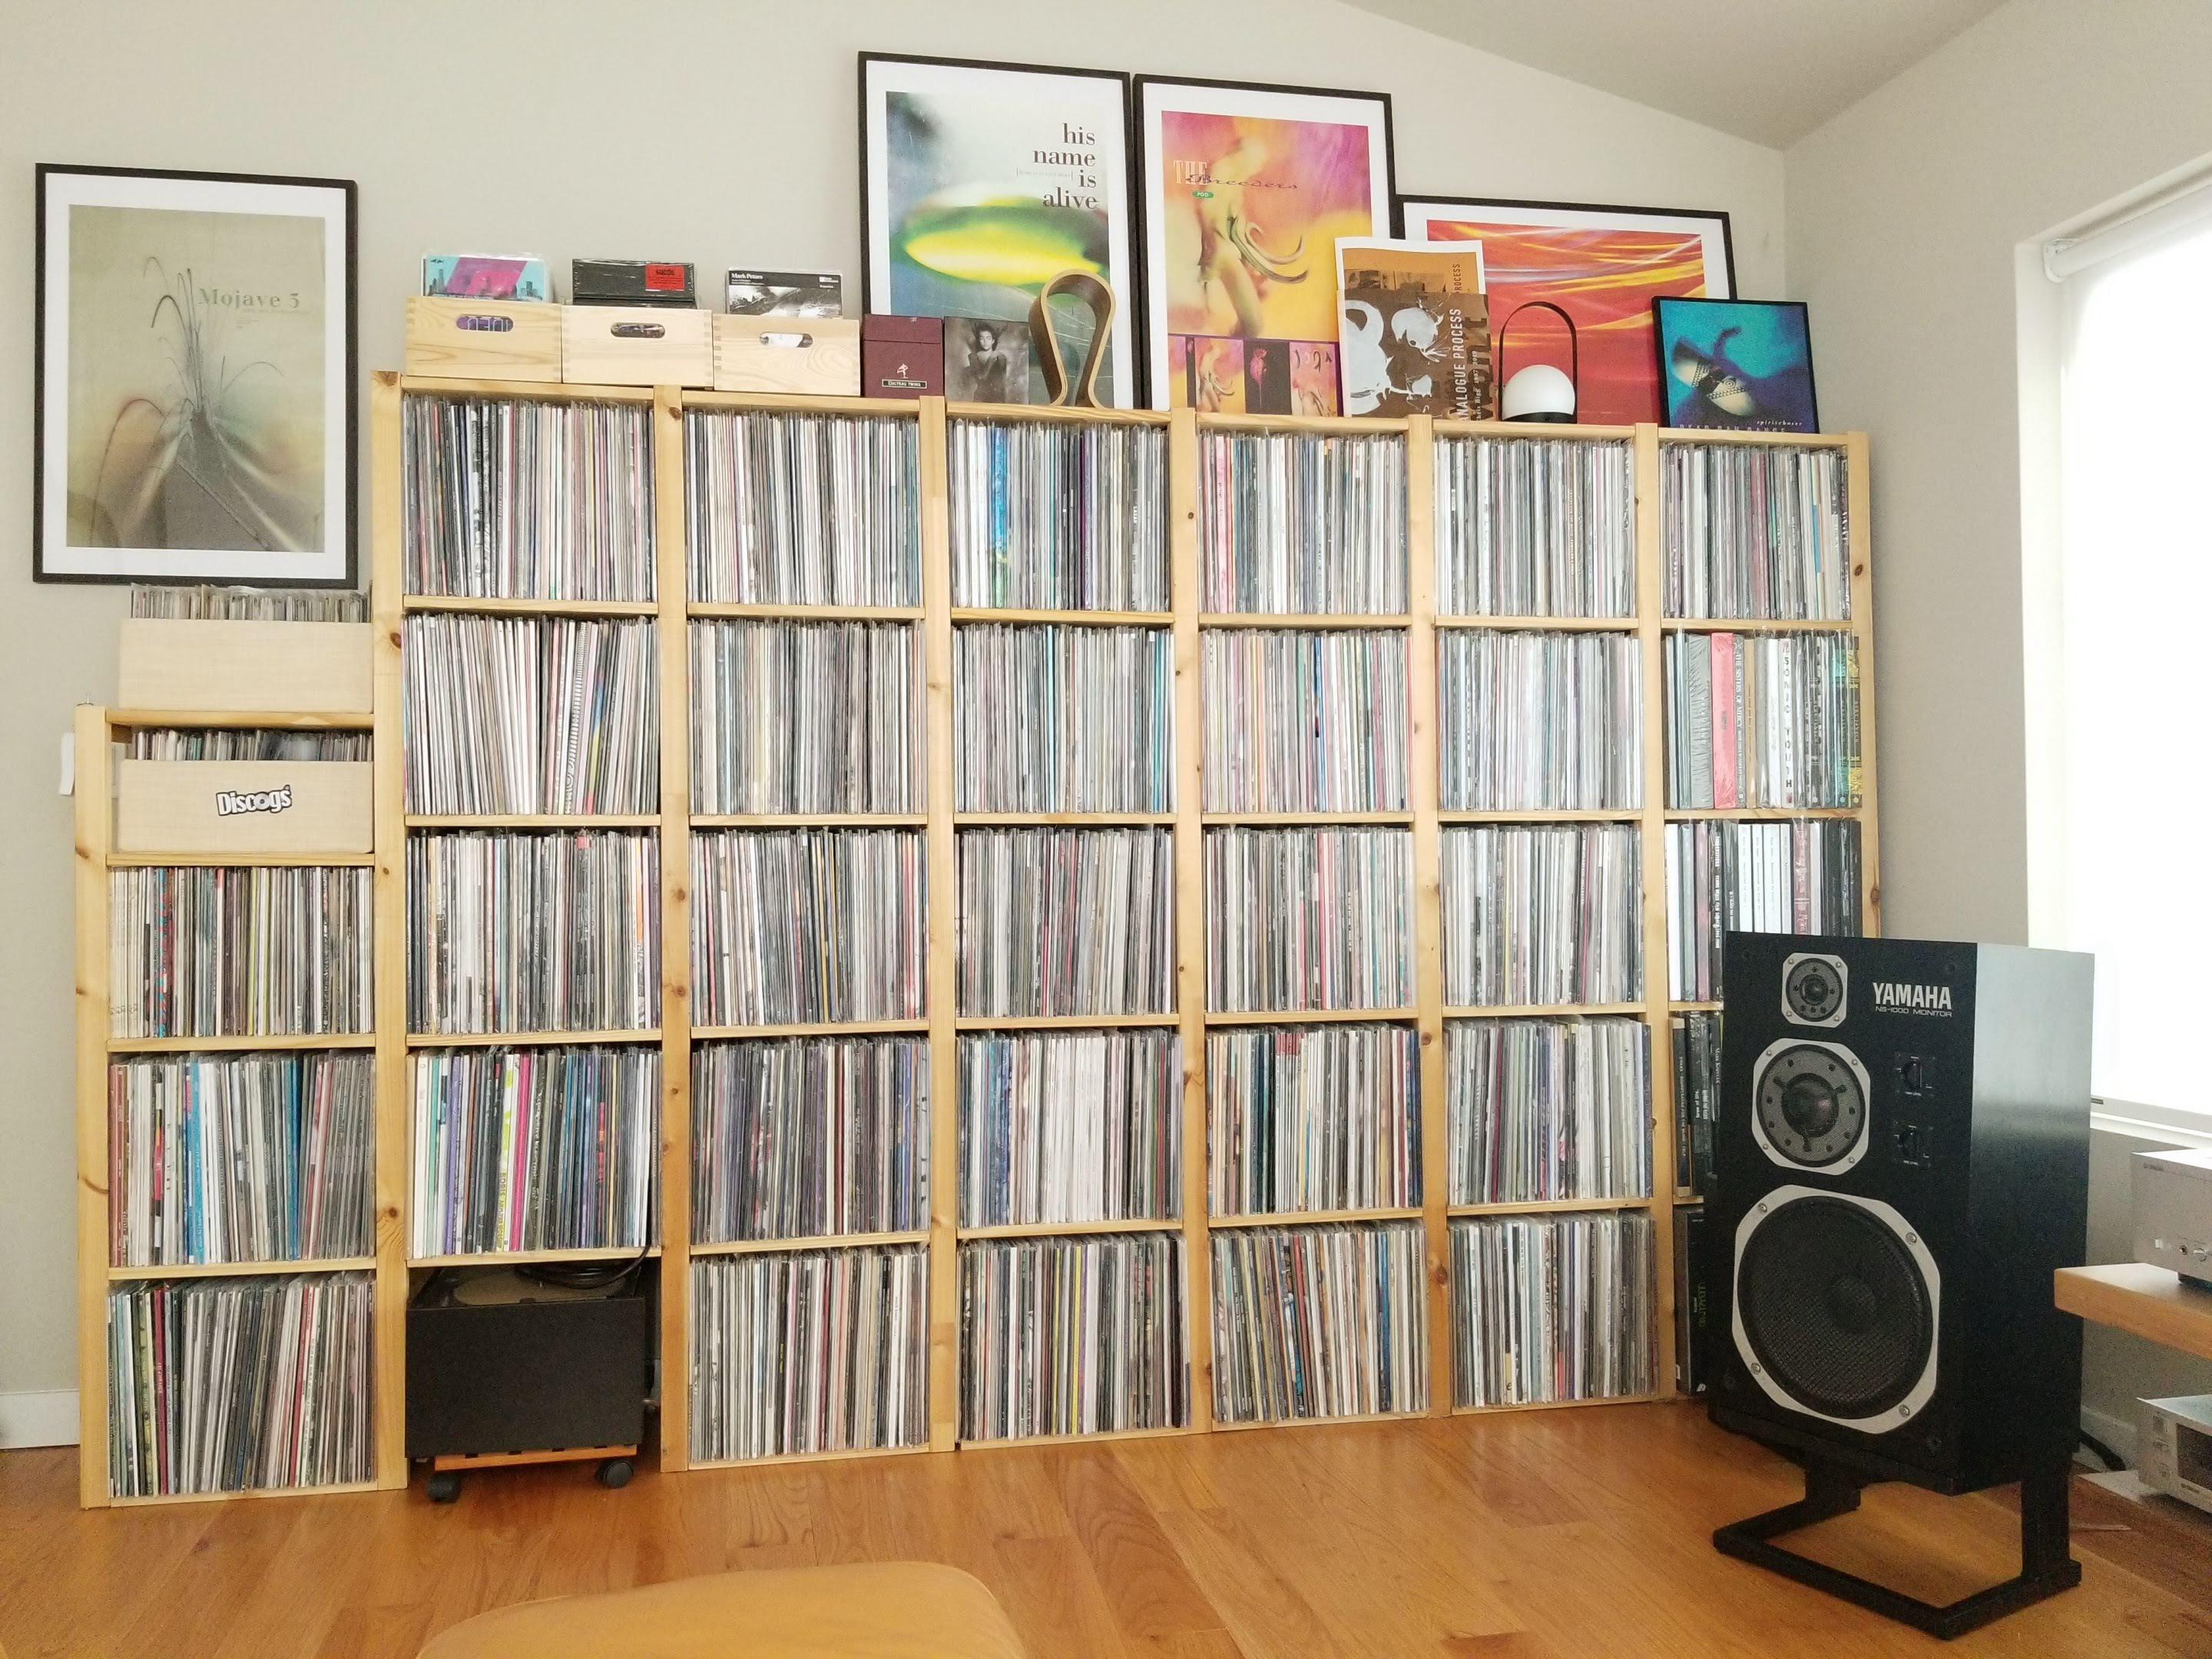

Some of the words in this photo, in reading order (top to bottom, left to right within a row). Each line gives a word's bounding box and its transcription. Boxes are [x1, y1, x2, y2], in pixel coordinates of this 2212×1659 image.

[1061, 123, 1095, 145] his
[1032, 150, 1096, 167] name
[1078, 169, 1097, 188] is
[1174, 160, 1207, 185] THE
[1042, 187, 1100, 209] alive
[1452, 263, 1462, 293] ROCESS
[199, 288, 281, 310] Mojave
[1449, 309, 1465, 359] PROCESS
[216, 784, 293, 816] Discogs
[1873, 982, 1952, 1010] YAMAHA
[1912, 1009, 1952, 1018] MONITOR
